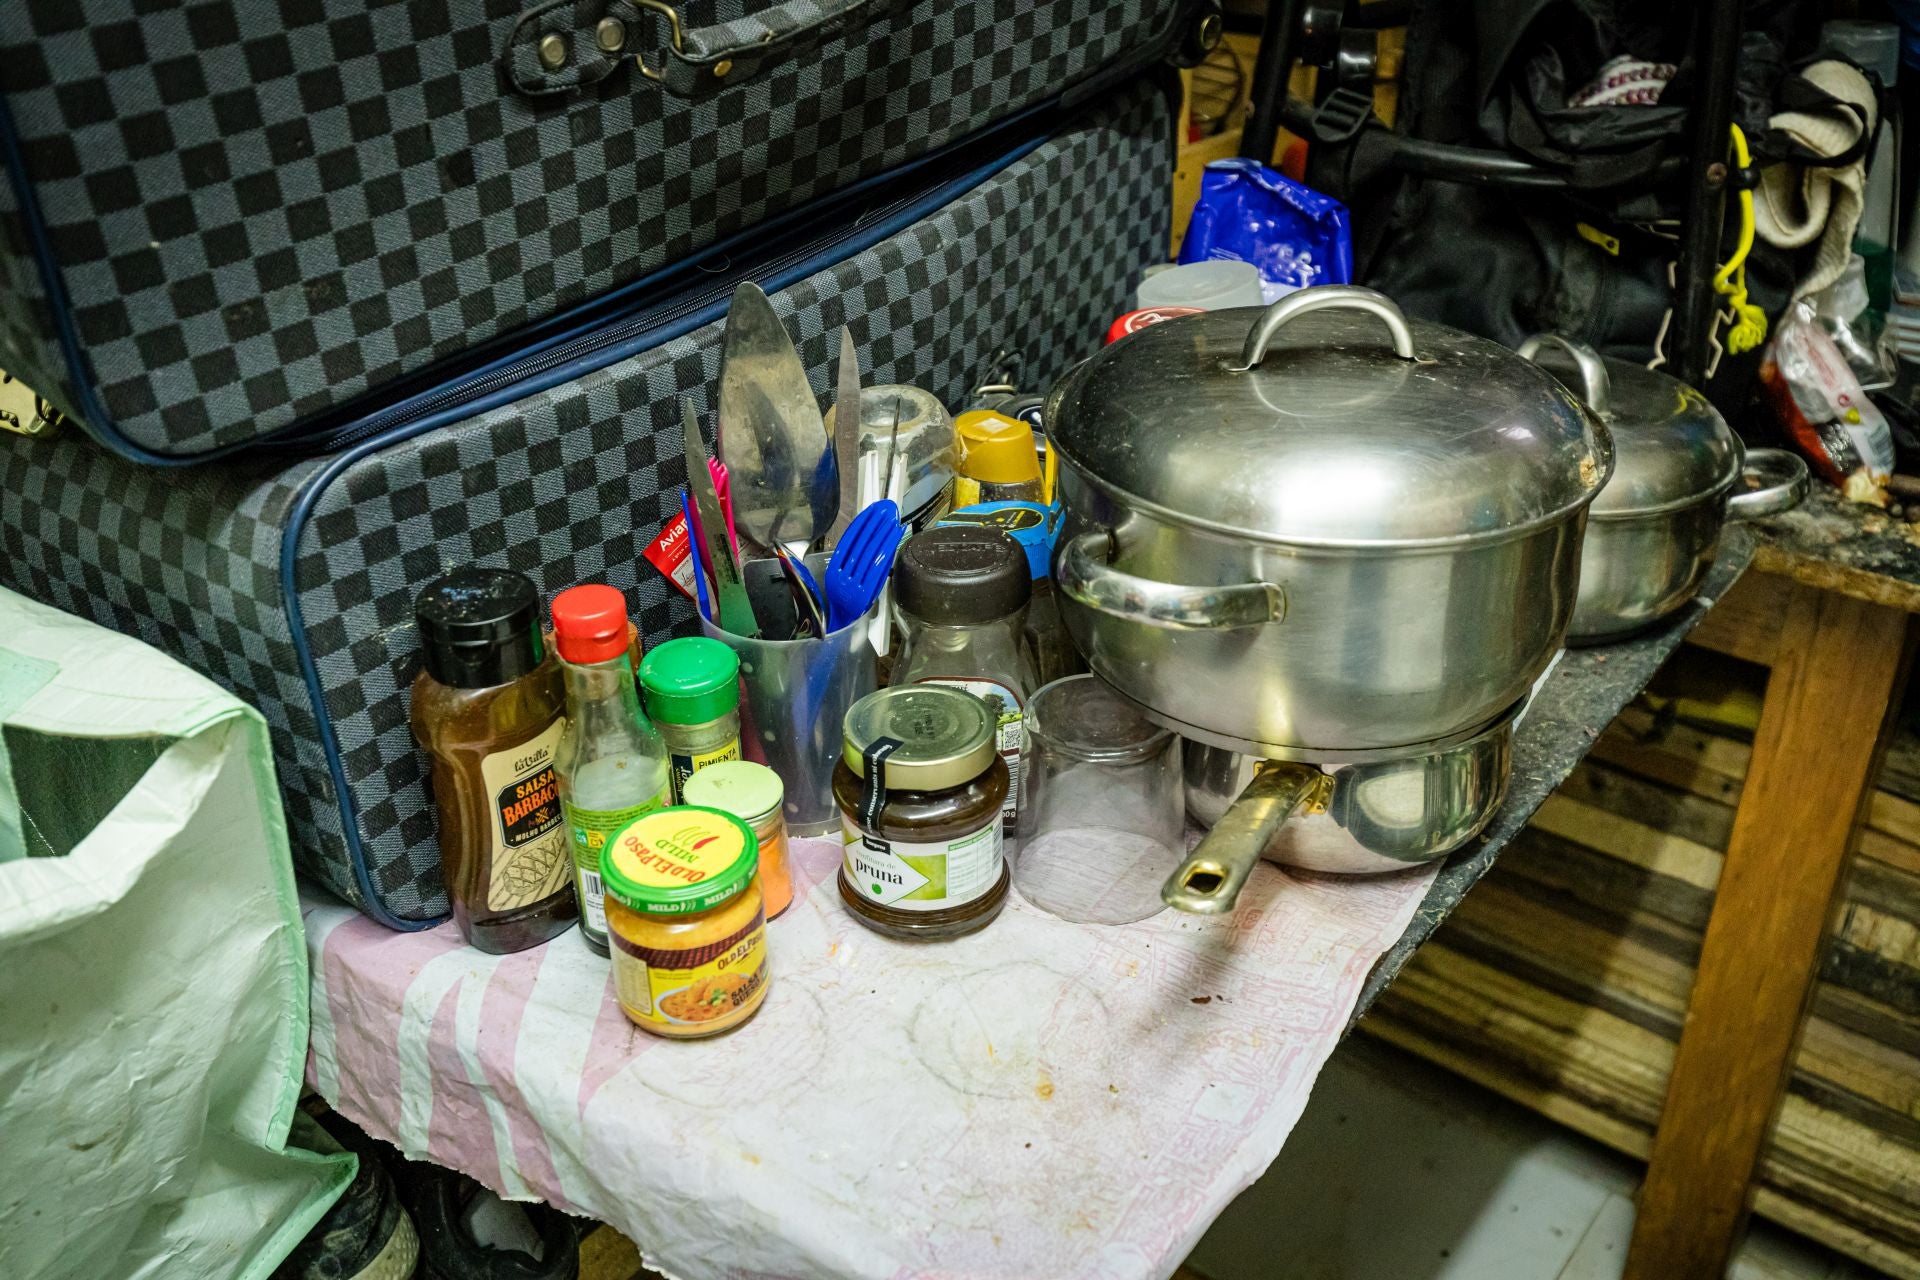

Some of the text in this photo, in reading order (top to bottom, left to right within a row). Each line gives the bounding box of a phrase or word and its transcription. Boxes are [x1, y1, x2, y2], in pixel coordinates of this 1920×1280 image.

[698, 747, 737, 769] PIMIENTA
[515, 769, 555, 799] SALSA
[515, 828, 539, 843] MOLHO
[655, 839, 700, 864] MILD
[670, 865, 706, 883] OLD
[855, 858, 903, 886] pruna
[704, 888, 734, 906] MILD
[647, 903, 681, 912] MILD
[717, 953, 736, 971] OLD
